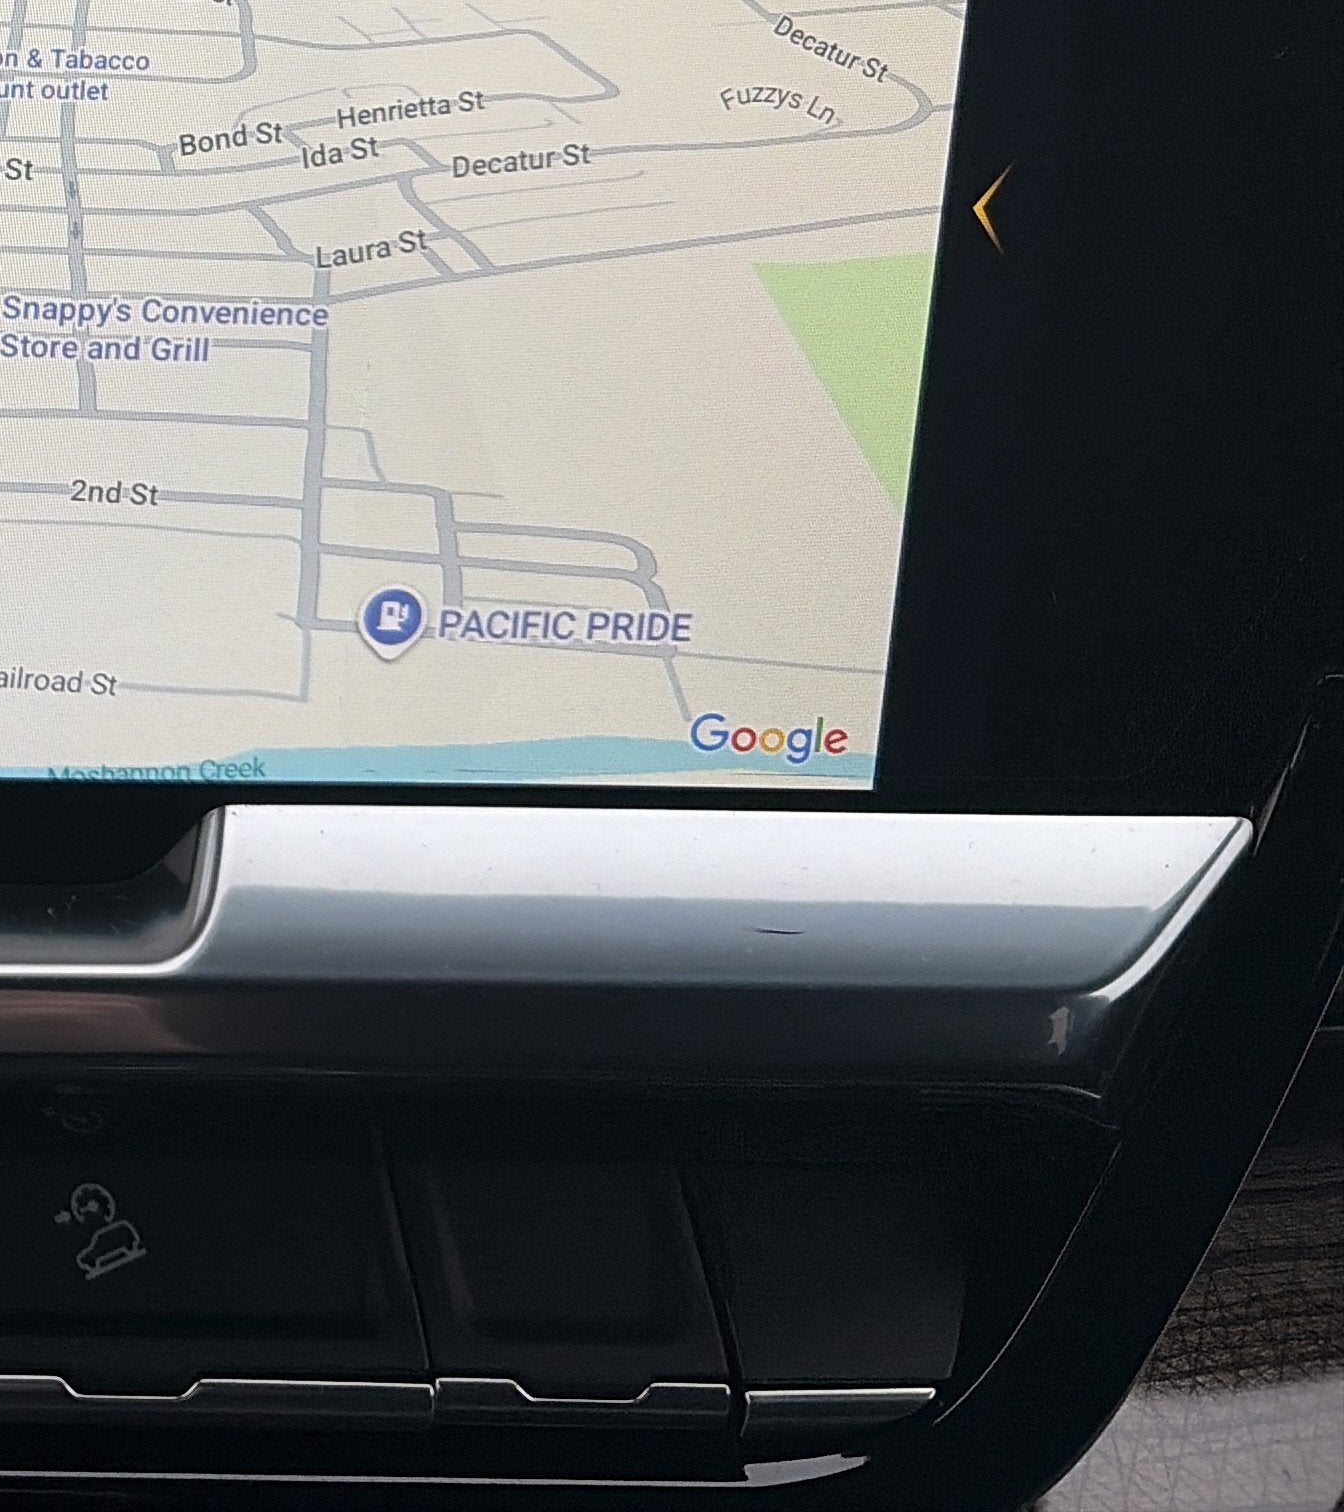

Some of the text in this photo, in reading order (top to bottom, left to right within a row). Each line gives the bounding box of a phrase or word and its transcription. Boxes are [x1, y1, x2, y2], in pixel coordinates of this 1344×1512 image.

[27, 49, 43, 70] &
[52, 49, 150, 71] Tabacco
[773, 16, 890, 84] Decatur St
[41, 80, 108, 101] outlet
[720, 86, 837, 125] Fuzzys Ln
[337, 90, 485, 130] Henrietta St
[180, 122, 283, 157] Bond St
[301, 137, 379, 170] Ida St
[5, 158, 34, 182] St
[452, 142, 591, 178] Decatur St
[316, 230, 428, 269] Laura St
[3, 296, 329, 328] Snappy's Convenience
[0, 336, 209, 362] Store and Grill
[70, 480, 158, 506] 2nd St
[438, 609, 693, 642] PACIFIC PRIDE
[90, 671, 117, 696] St
[690, 712, 847, 763] Google
[199, 757, 266, 781] Creek
